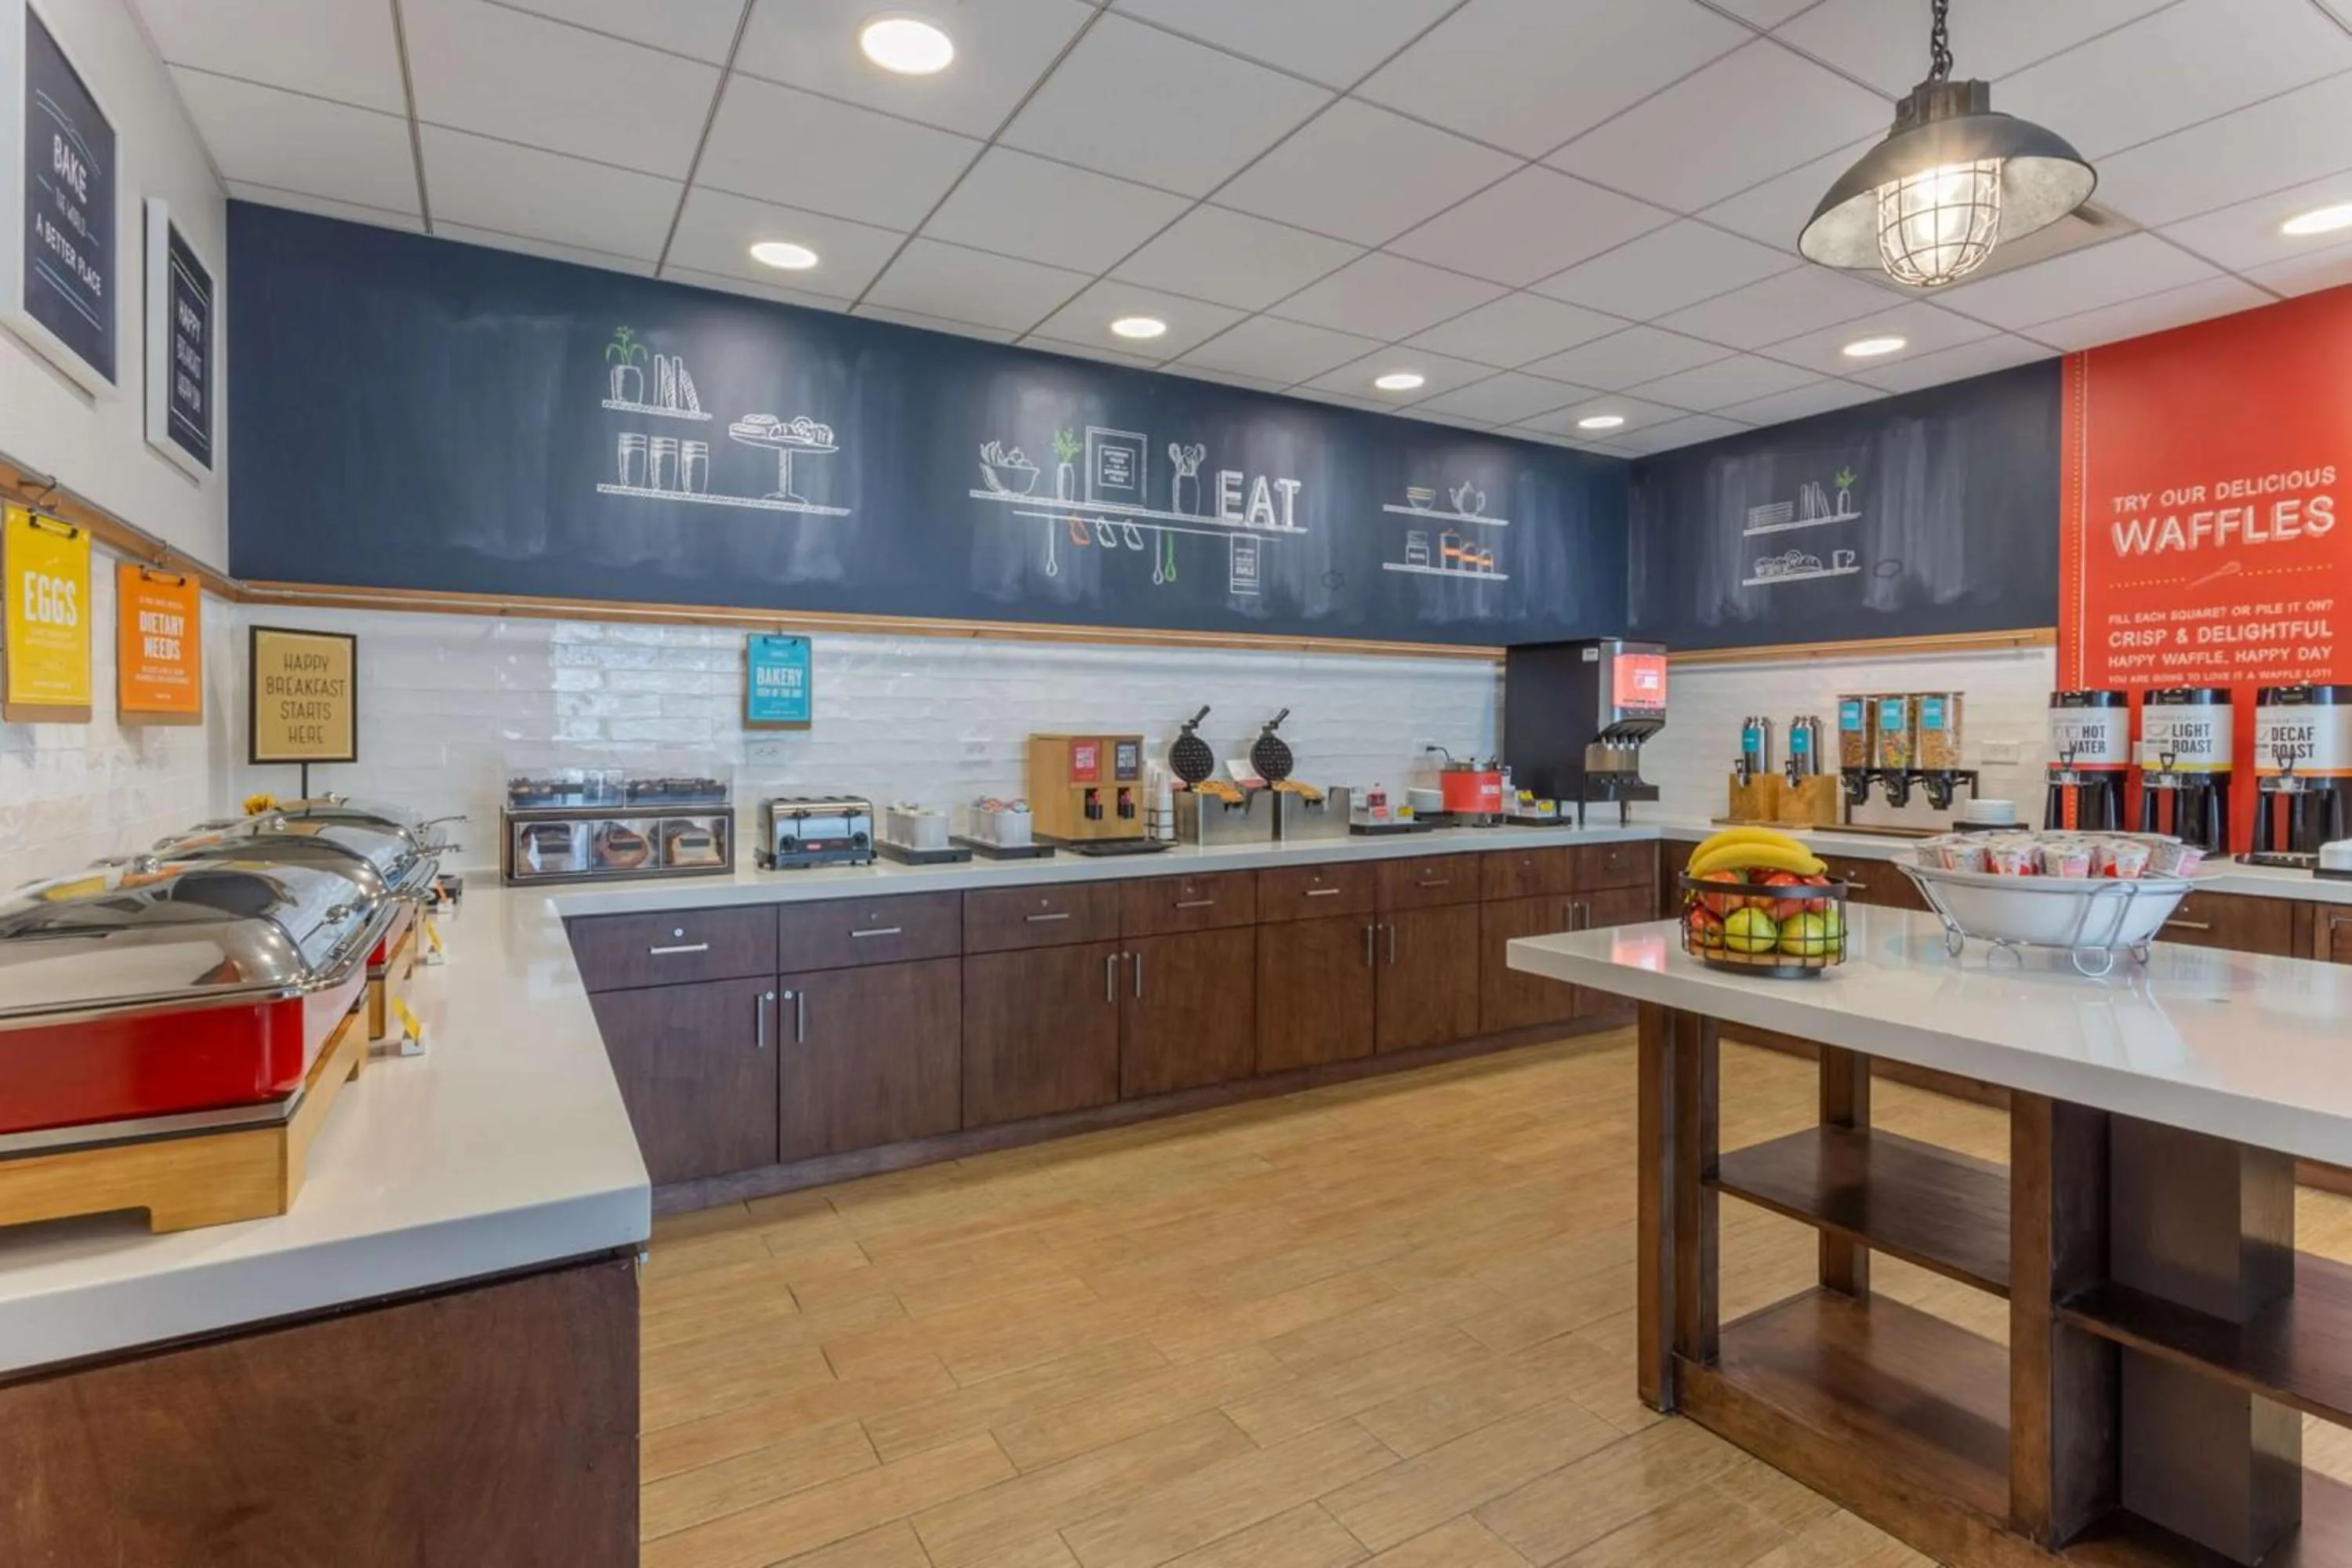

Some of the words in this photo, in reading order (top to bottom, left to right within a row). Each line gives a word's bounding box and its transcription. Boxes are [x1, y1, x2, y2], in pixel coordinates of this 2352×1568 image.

[54, 134, 86, 204] BAKE
[35, 212, 42, 235] A
[45, 221, 76, 270] BETTER
[78, 256, 100, 296] PLACE
[1216, 470, 1301, 528] EAT
[2114, 494, 2151, 513] TRY
[2160, 486, 2206, 506] OUR
[2216, 466, 2336, 499] DELICIOUS
[2111, 495, 2335, 557] WAFFLES
[24, 571, 77, 626] EGGS
[2109, 614, 2130, 624] FILL
[2135, 612, 2165, 623] EACH
[2170, 606, 2227, 620] SQUARE?
[2231, 605, 2251, 616] OR
[2256, 603, 2283, 615] PILE
[2288, 601, 2300, 612] IT
[2306, 599, 2333, 612] ON?
[140, 610, 183, 637] DIETARY
[2108, 629, 2167, 648] CRISP
[2176, 627, 2188, 644] &
[2197, 619, 2333, 644] DELIGHTFUL
[144, 637, 180, 661] NEEDS
[2108, 653, 2155, 668] HAPPY
[2235, 647, 2290, 662] HAPPY
[2298, 645, 2332, 660] DAY
[283, 652, 329, 673] HAPPY
[757, 666, 802, 686] BAKERY
[2247, 670, 2255, 680] A
[2259, 669, 2302, 679] WAFFLE
[266, 676, 345, 697] BREAKFAST
[280, 700, 332, 720] STARTS
[289, 724, 325, 744] HERE
[2082, 724, 2106, 739] HOT
[2172, 723, 2211, 738] LIGHT
[2271, 727, 2314, 742] DECAF
[2070, 740, 2106, 753] WATER
[2172, 739, 2213, 753] ROAST
[2271, 743, 2314, 759] ROAST
